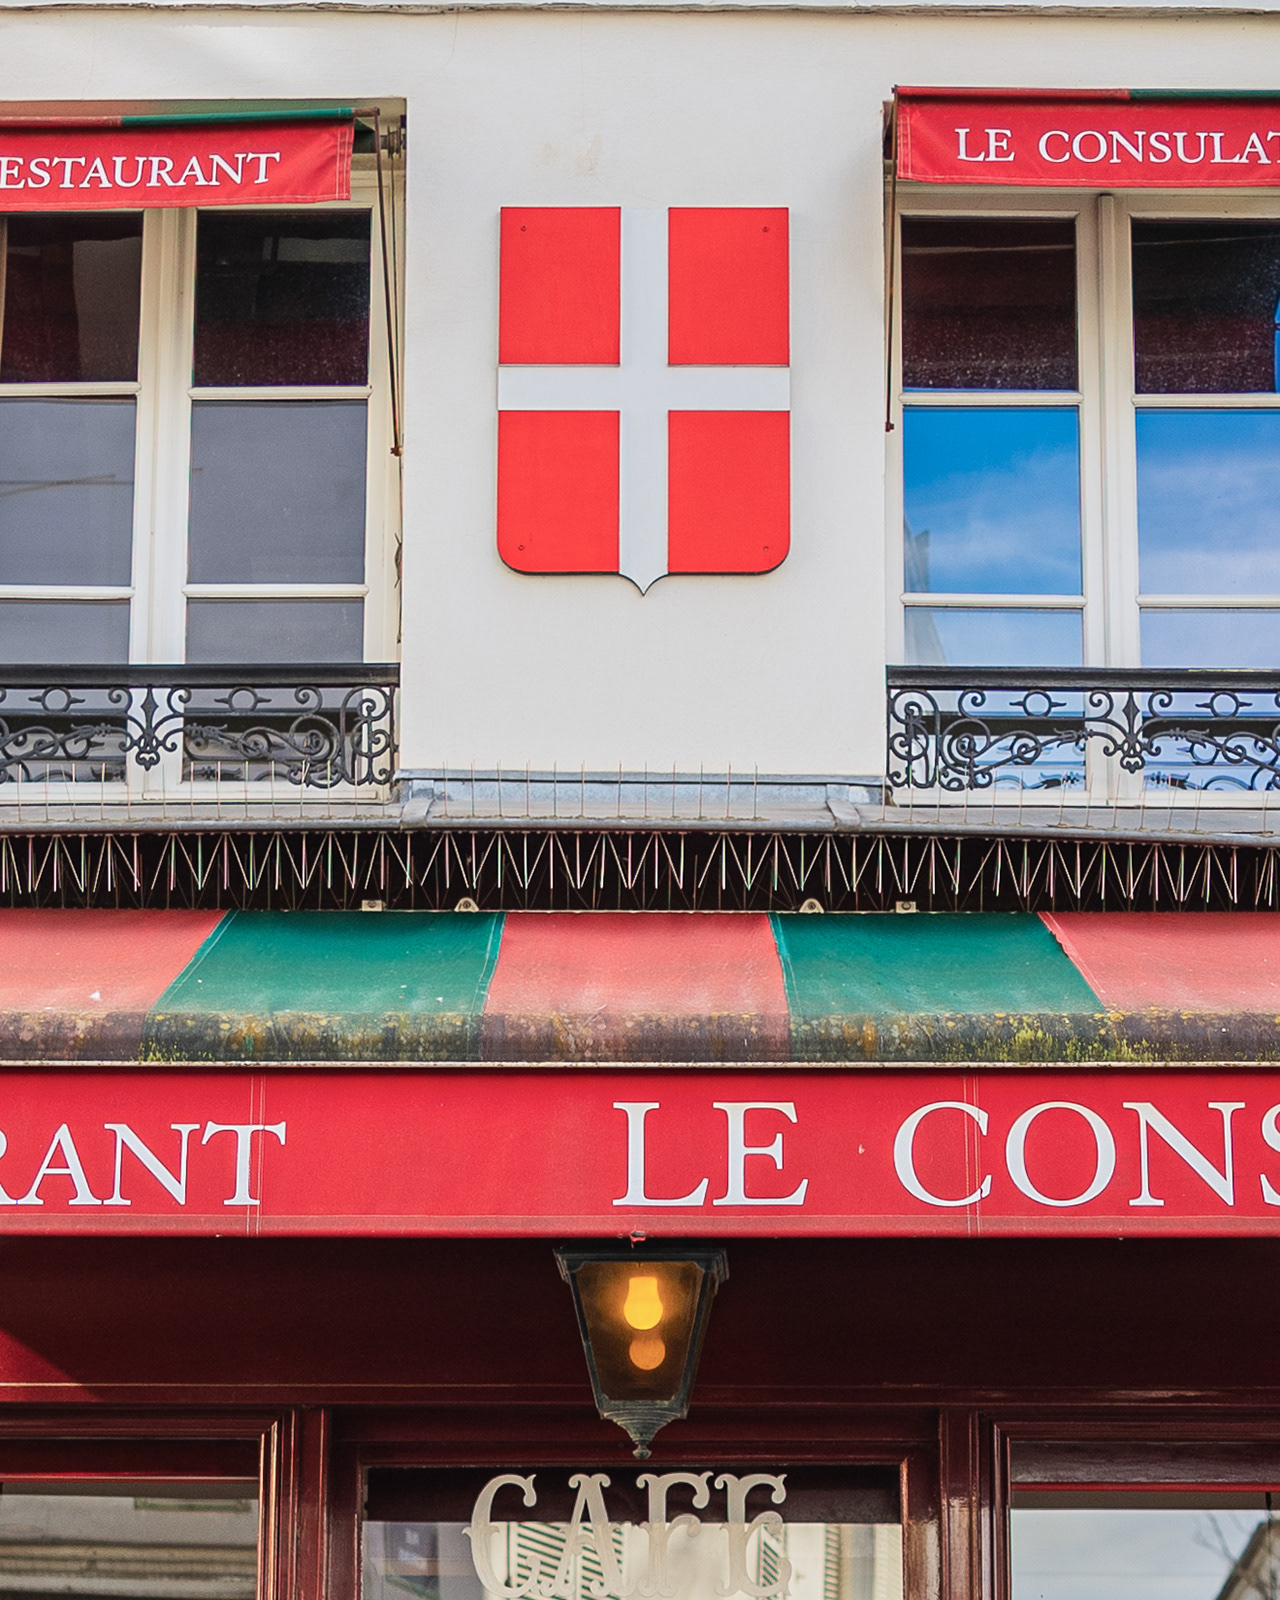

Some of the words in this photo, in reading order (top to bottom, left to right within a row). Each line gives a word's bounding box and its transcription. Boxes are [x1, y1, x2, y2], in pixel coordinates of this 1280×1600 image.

[954, 126, 1015, 165] LE
[611, 1100, 810, 1207] LE
[462, 1471, 792, 1599] CAFE
